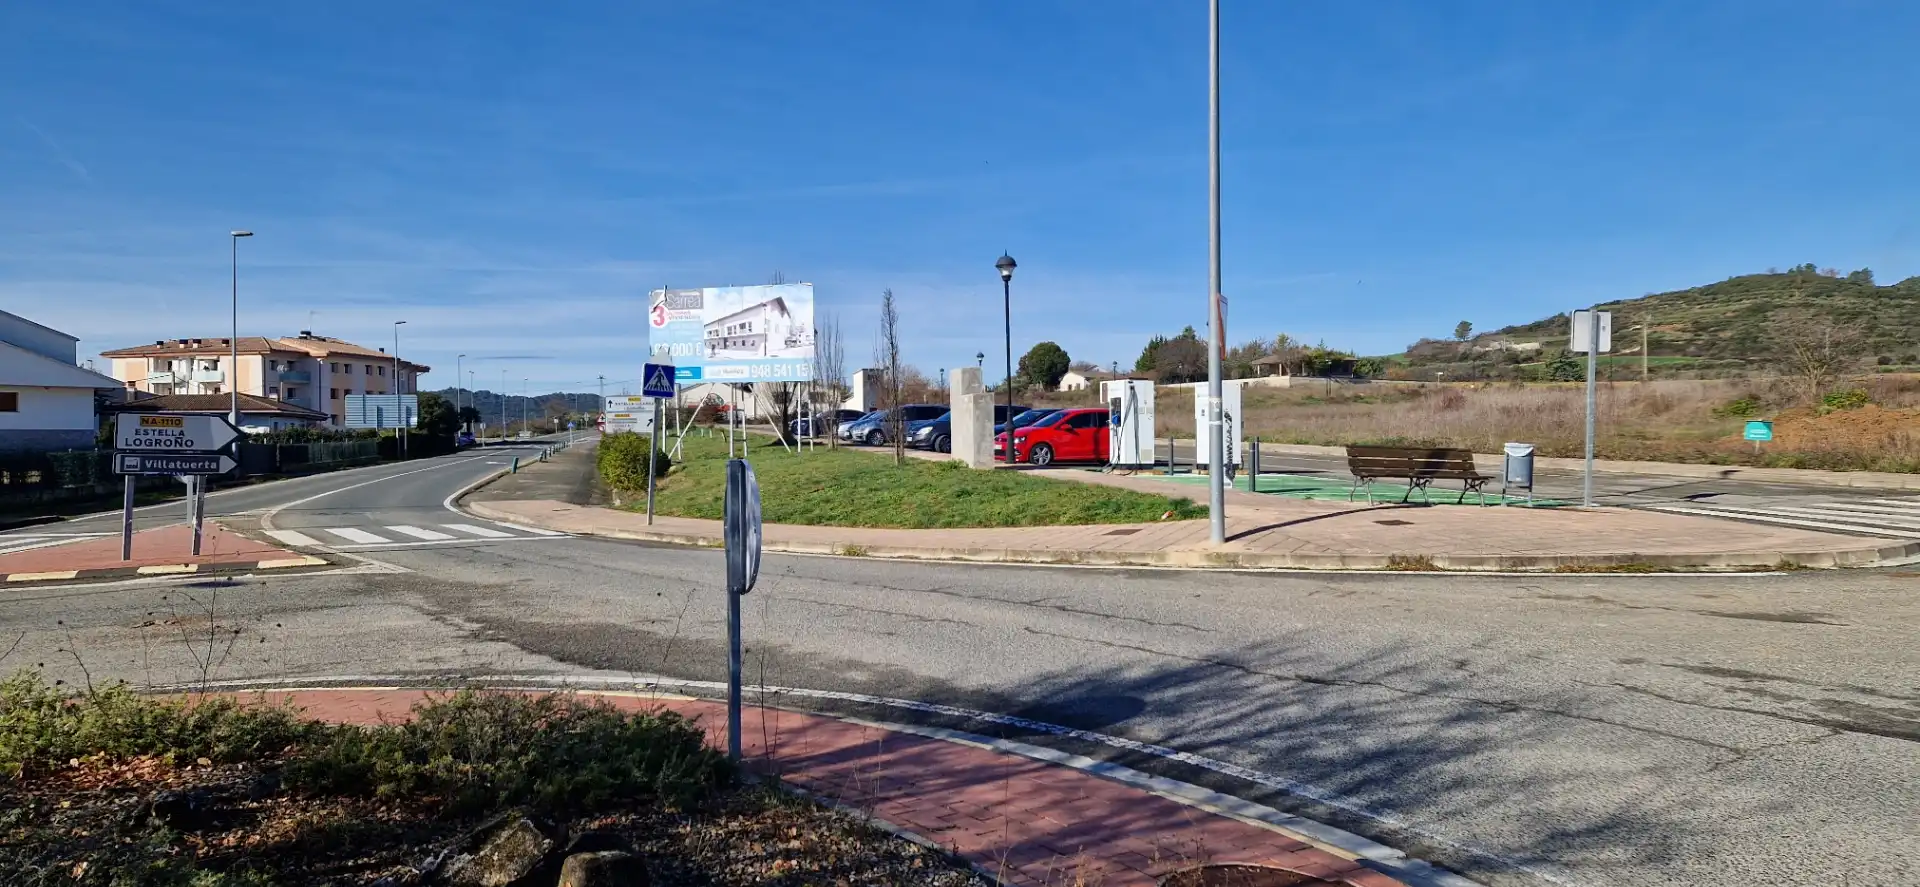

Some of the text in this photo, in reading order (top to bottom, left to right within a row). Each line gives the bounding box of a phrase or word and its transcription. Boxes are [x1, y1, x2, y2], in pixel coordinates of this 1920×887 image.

[653, 305, 665, 326] 3
[751, 364, 771, 378] 948
[774, 364, 792, 378] 541
[142, 418, 181, 426] NA-1110
[135, 429, 185, 437] ESTELLA
[125, 437, 194, 448] LOGROÑO
[145, 460, 217, 469] Villatuerta
